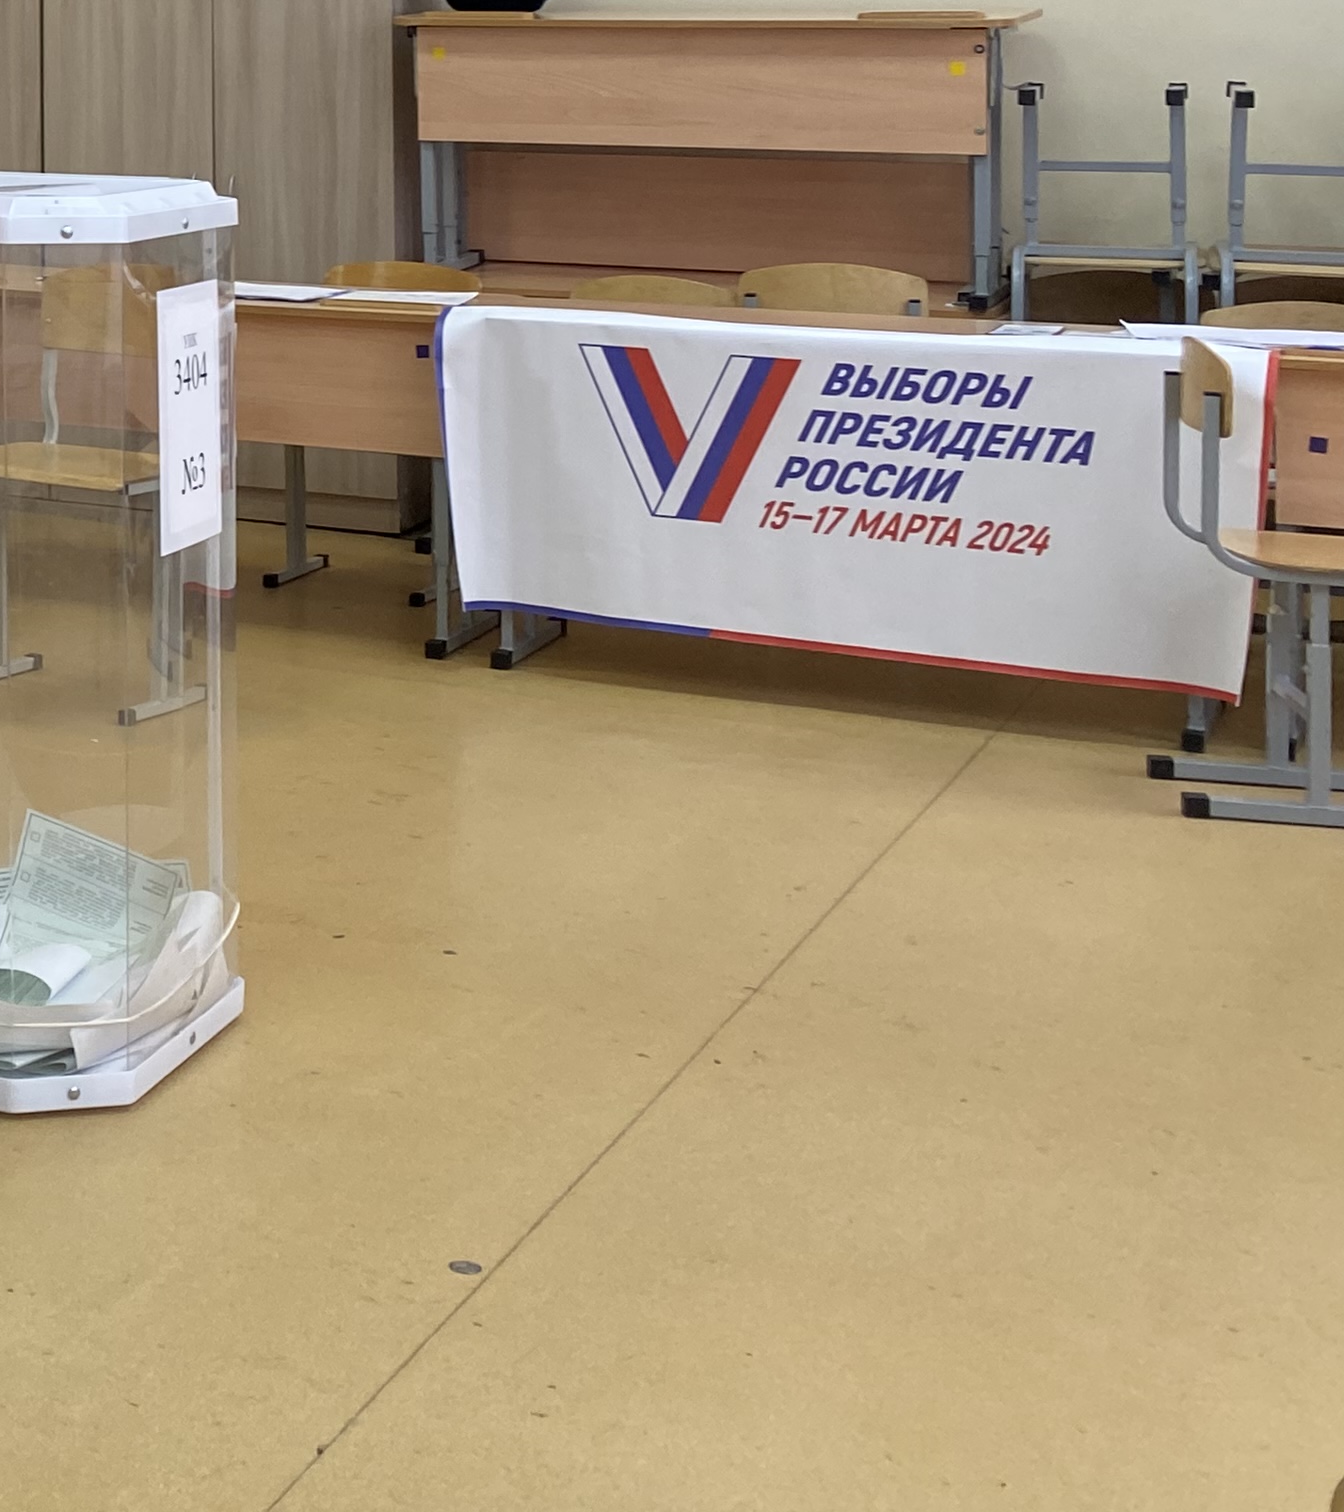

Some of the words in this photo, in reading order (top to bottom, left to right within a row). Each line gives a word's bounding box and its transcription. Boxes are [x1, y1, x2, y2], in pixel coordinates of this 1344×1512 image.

[174, 351, 208, 395] 3404
[820, 362, 1034, 410] ВЫБОРЫ
[797, 409, 1096, 467] ПРЕЗИДЕНТА
[181, 452, 206, 495] №3
[775, 455, 965, 504] РОССИИ
[848, 508, 963, 548] МАРТА
[967, 520, 1052, 557] 2024
